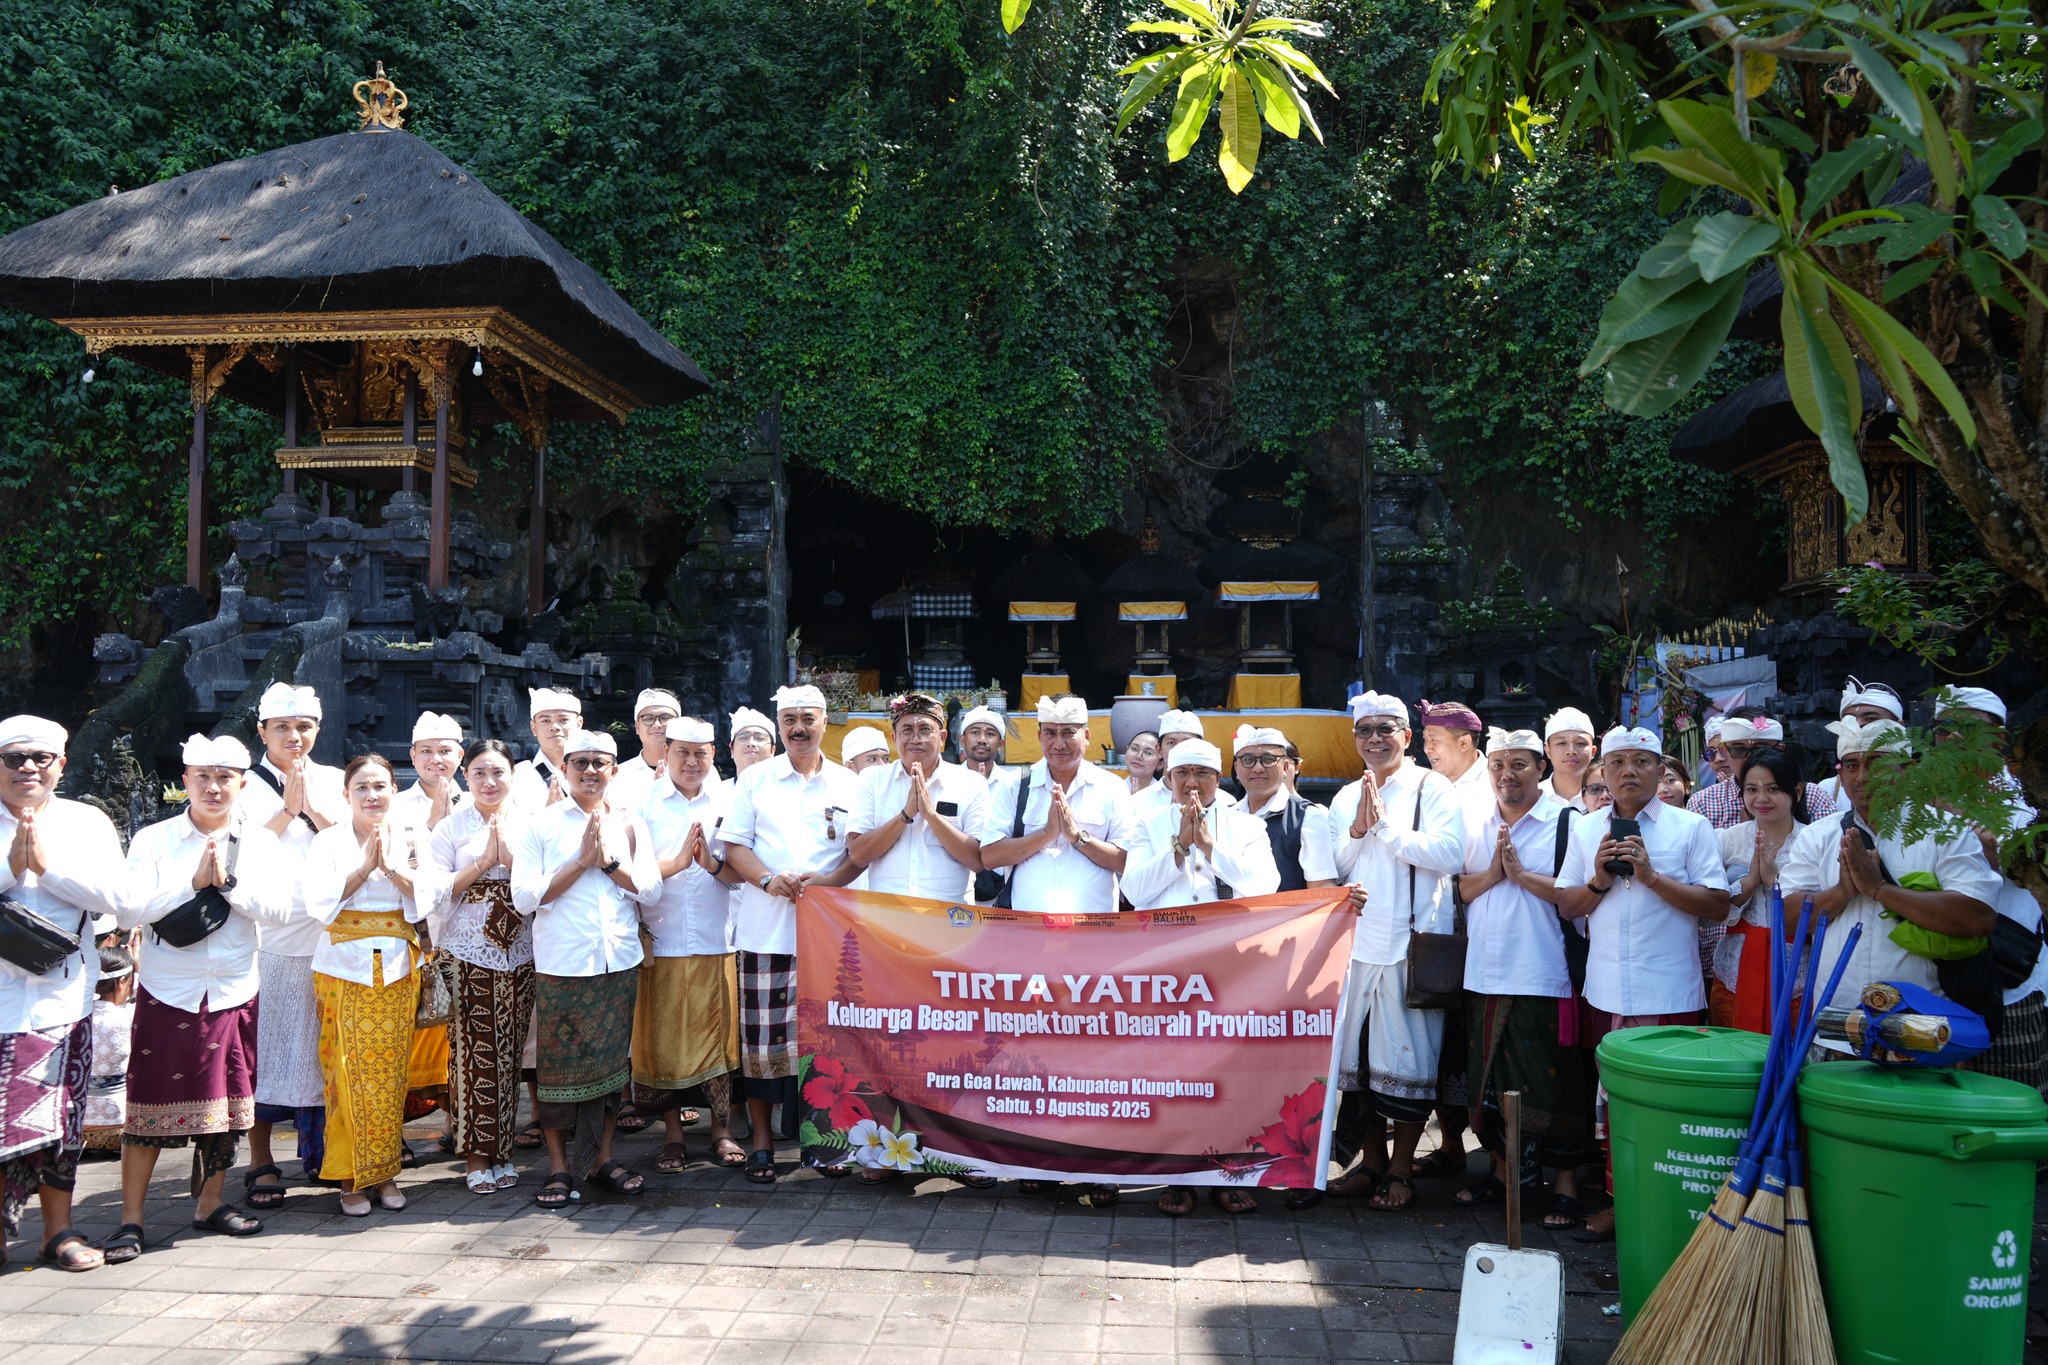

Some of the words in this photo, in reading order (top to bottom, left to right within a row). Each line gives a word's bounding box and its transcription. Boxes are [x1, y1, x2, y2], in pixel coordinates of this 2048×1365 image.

[1102, 920, 1116, 928] Maju
[1176, 915, 1197, 923] HITA
[932, 970, 1054, 1003] TIRTA
[1062, 974, 1214, 1003] YATRA
[827, 1000, 912, 1034] Keluarga
[917, 1004, 979, 1032] Besar
[984, 1007, 1109, 1037] Inspektorat
[1114, 1010, 1192, 1037] Daerah
[1196, 1009, 1287, 1037] Provinsi
[1292, 1009, 1333, 1036] Bali
[926, 1071, 961, 1089] Pura
[963, 1072, 992, 1090] Goa
[995, 1073, 1045, 1093] Lawah,
[1047, 1075, 1129, 1096] Kabupaten
[1131, 1078, 1215, 1098] Klungkung
[986, 1096, 1033, 1116] Sabtu,
[1036, 1098, 1046, 1115] 9
[1047, 1098, 1109, 1118] Agustus
[1111, 1101, 1151, 1119] 2025
[1680, 1123, 1748, 1139] SUMBAN
[1653, 1161, 1731, 1181] INSPEKTOR
[1682, 1181, 1723, 1195] PROV
